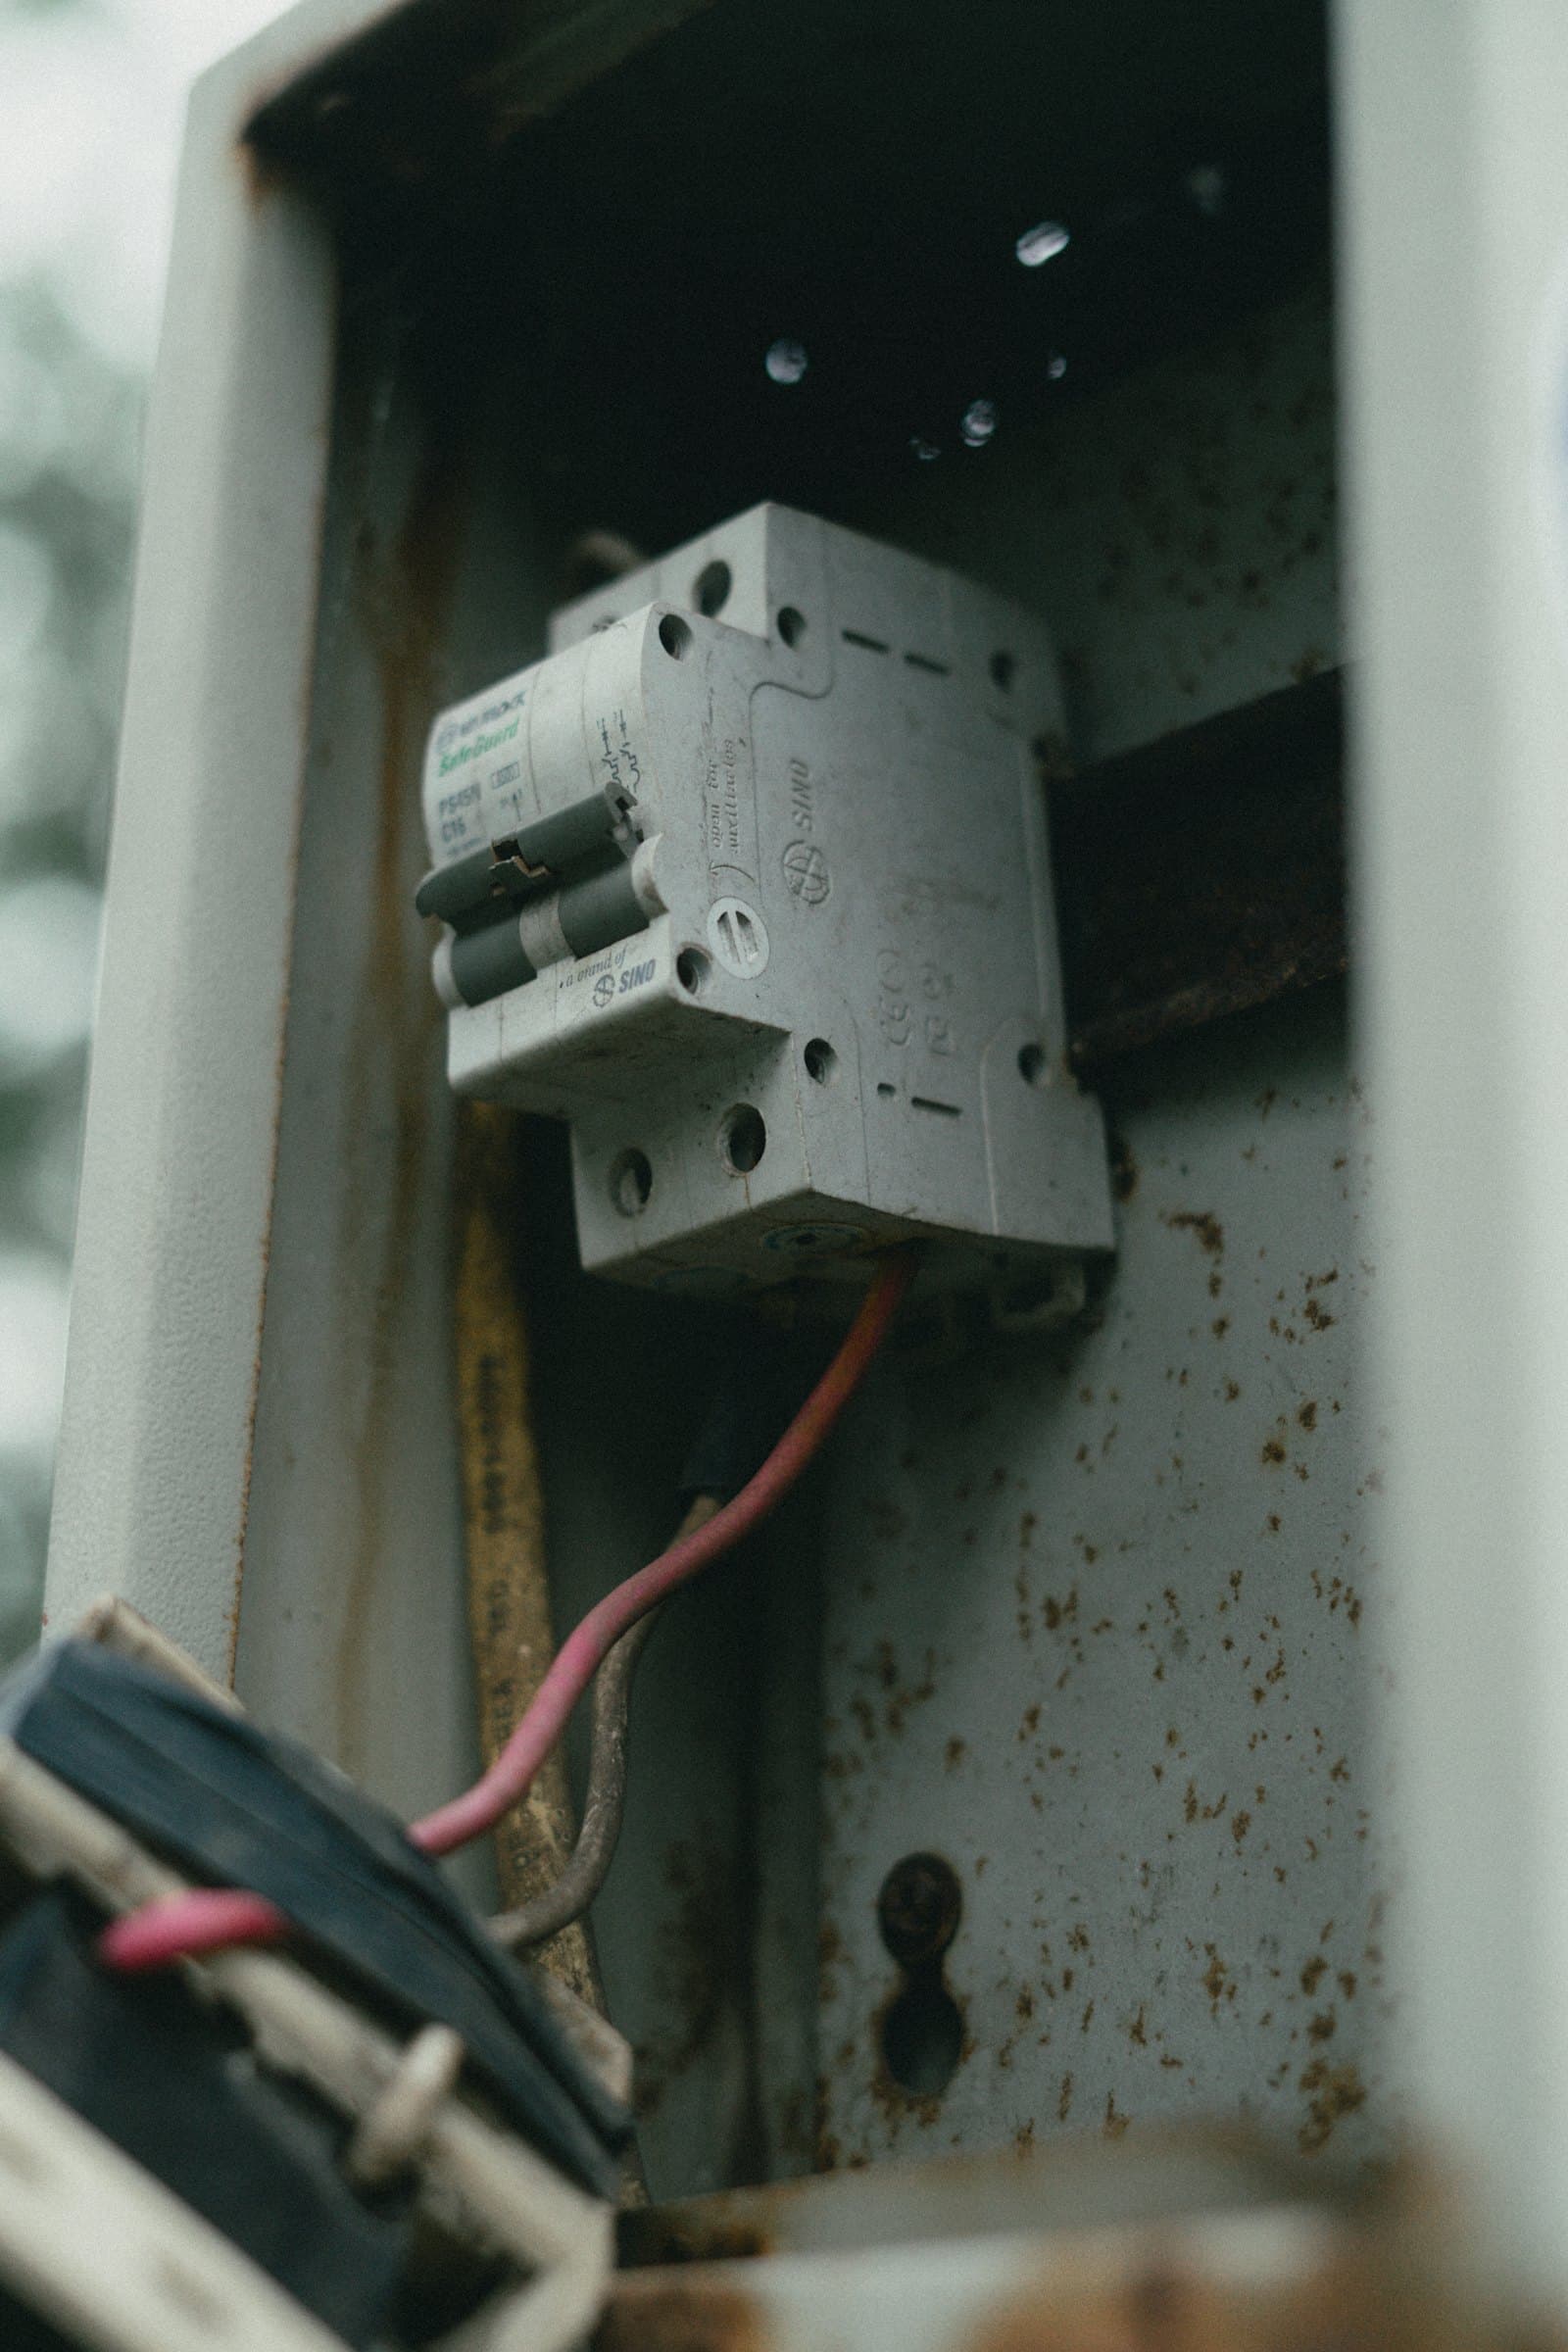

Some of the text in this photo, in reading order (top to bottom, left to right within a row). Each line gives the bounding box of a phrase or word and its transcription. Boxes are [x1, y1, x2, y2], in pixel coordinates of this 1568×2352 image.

[788, 757, 812, 831] SINO
[614, 941, 629, 969] of
[618, 958, 657, 993] SINO
